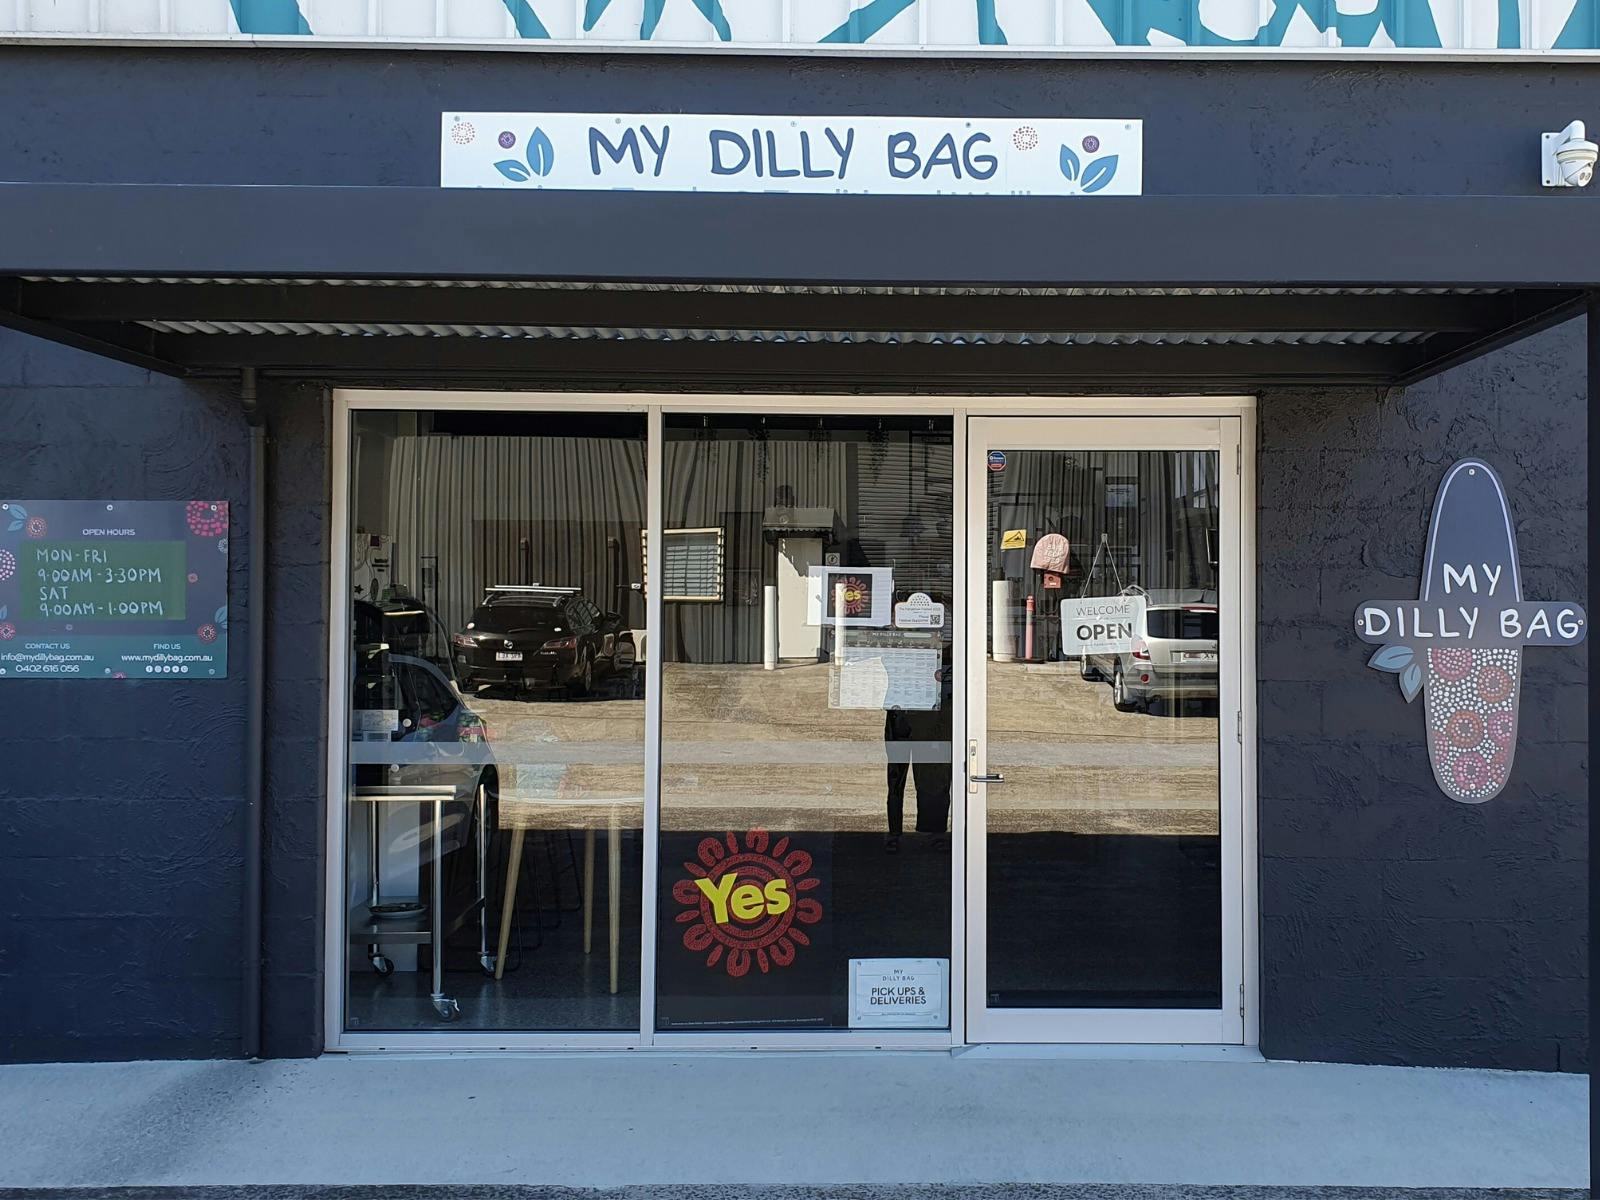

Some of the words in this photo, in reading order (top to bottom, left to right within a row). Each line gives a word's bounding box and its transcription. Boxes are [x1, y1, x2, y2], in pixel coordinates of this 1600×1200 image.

[589, 125, 670, 177] MY
[709, 127, 854, 180] DILLY
[887, 131, 998, 181] BAG
[1443, 563, 1501, 596] MY
[40, 586, 68, 601] SAT
[1076, 605, 1130, 616] WELCOME
[1364, 606, 1478, 639] DILLY
[1500, 609, 1579, 638] BAG
[1077, 623, 1132, 640] OPEN
[15, 664, 42, 673] 0402
[60, 664, 80, 673] 056
[695, 873, 791, 924] Yes
[871, 987, 895, 996] PICK
[897, 986, 916, 995] UPS
[918, 986, 925, 995] &
[870, 996, 927, 1005] DELIVERIES
